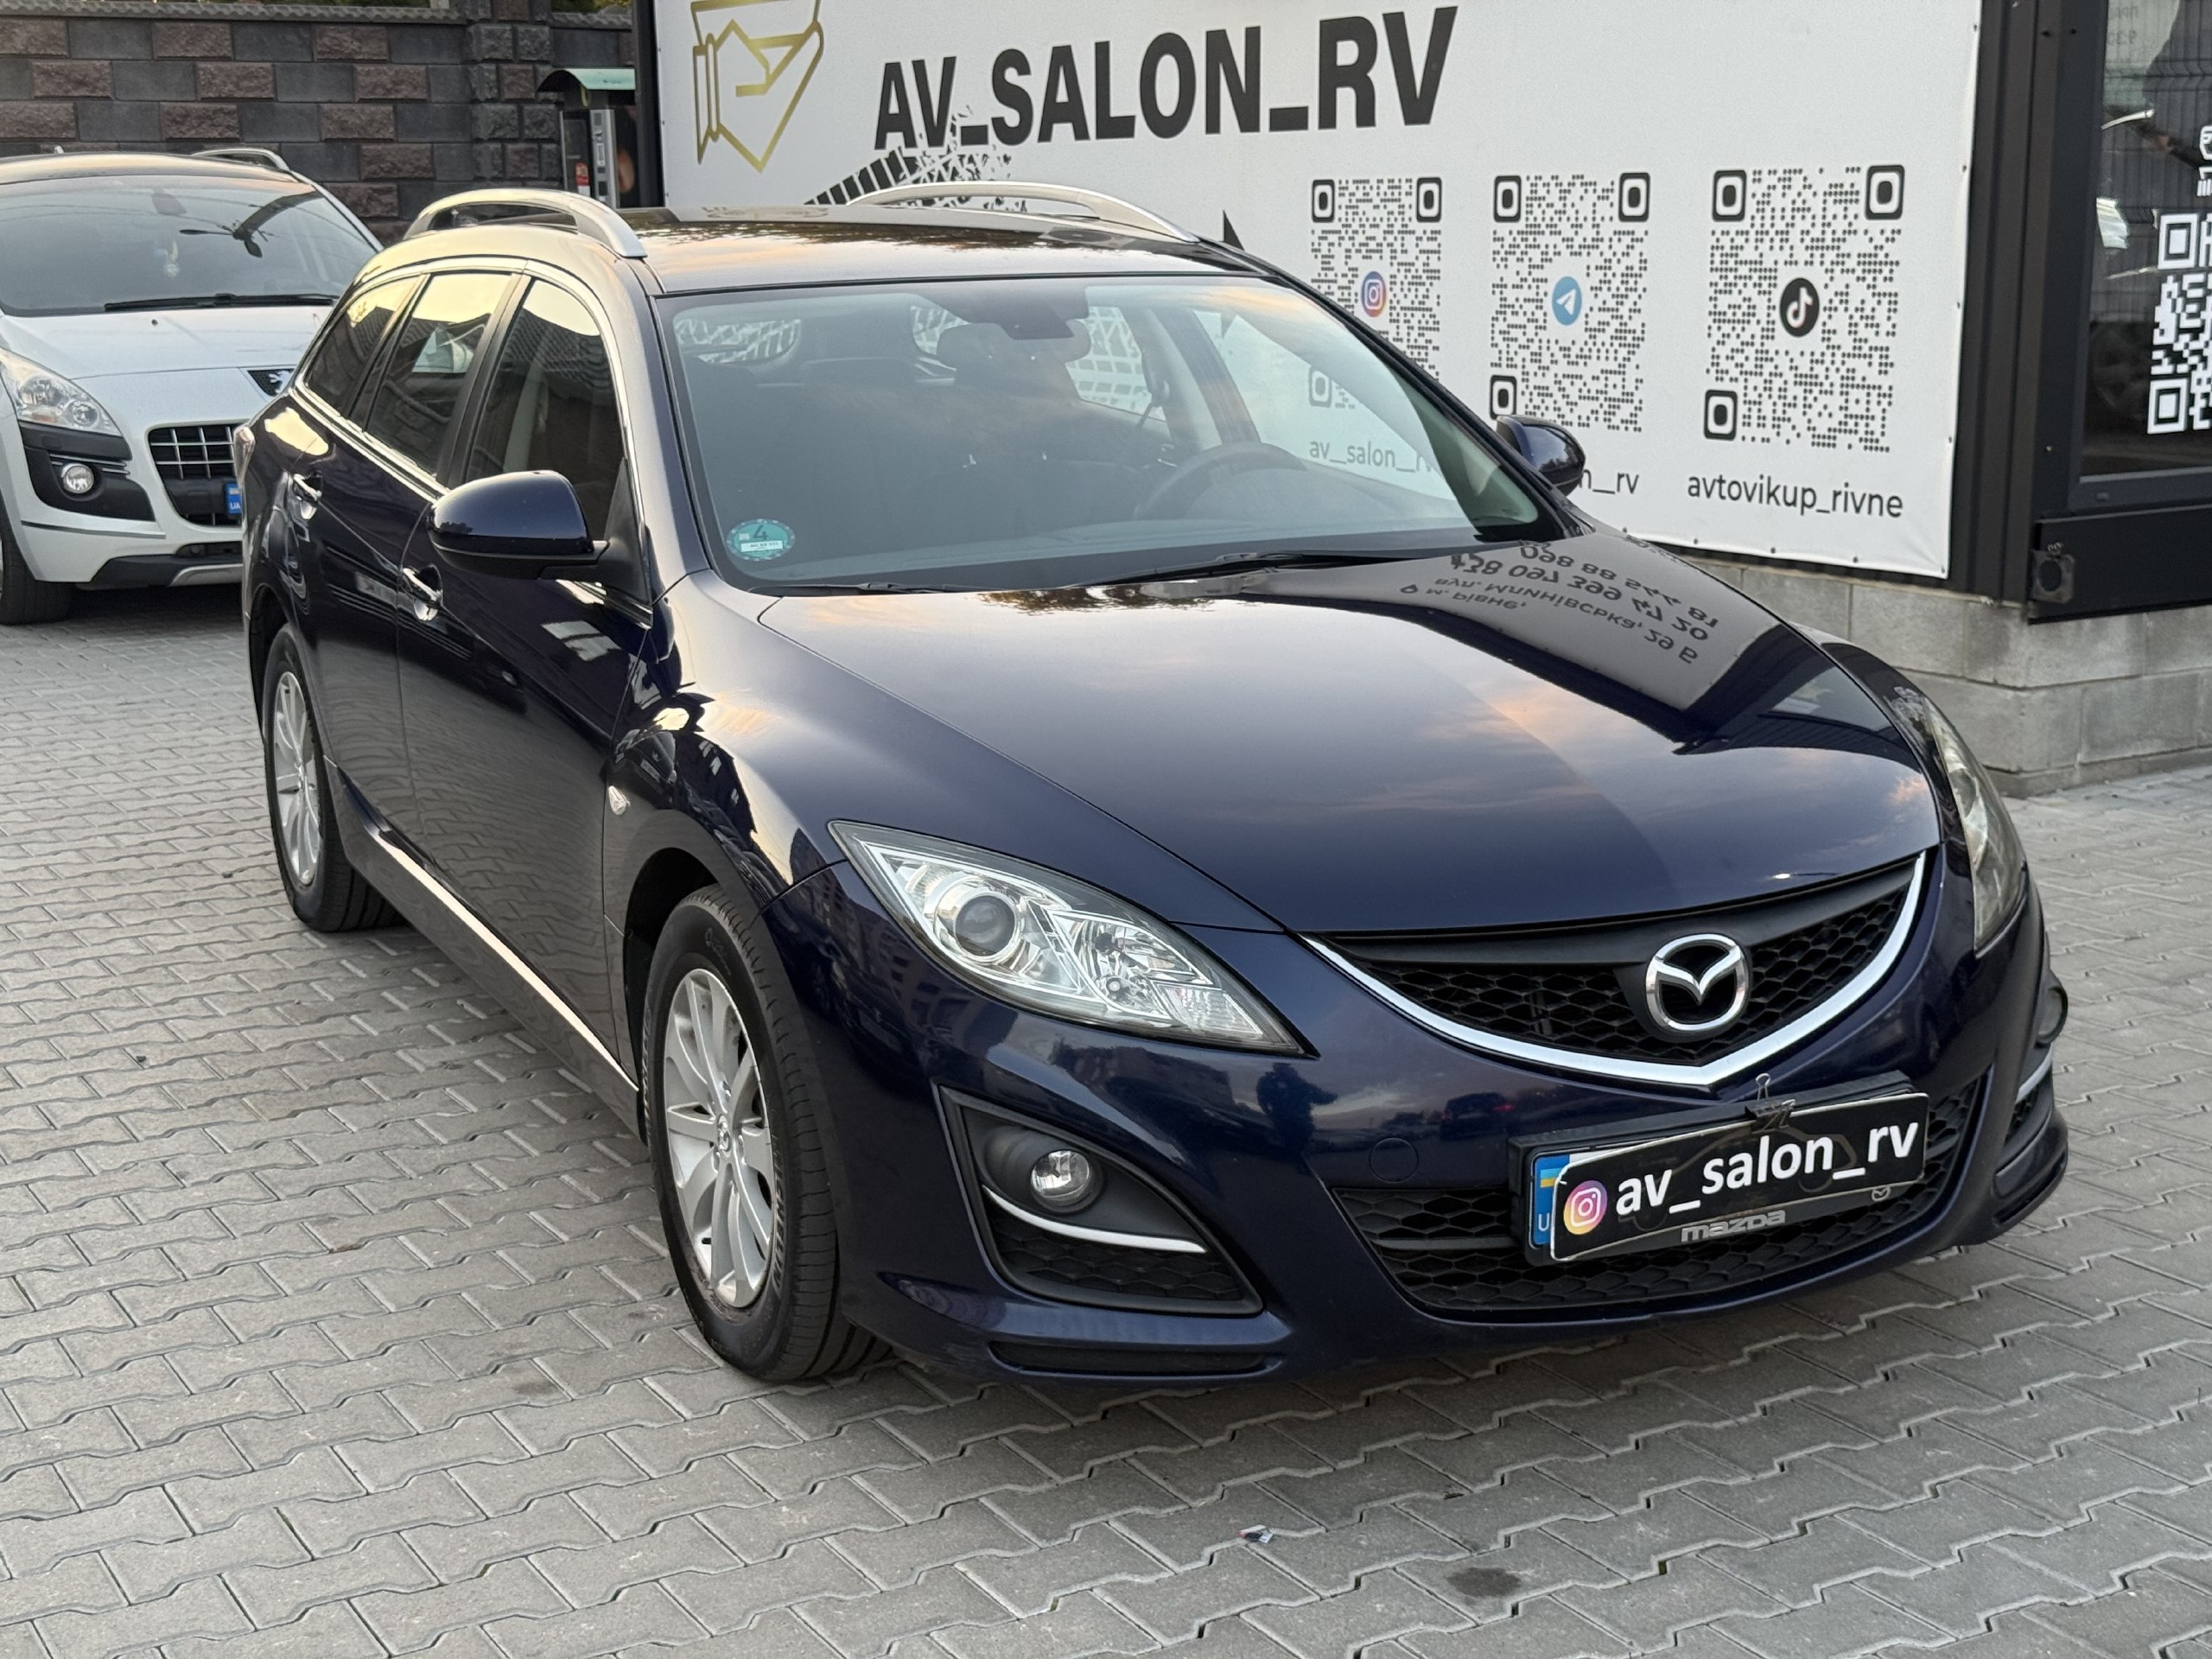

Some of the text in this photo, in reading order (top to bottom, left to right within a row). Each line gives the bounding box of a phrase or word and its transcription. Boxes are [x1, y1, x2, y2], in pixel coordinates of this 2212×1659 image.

[874, 5, 1459, 150] AV_SALON_RV
[1688, 474, 1904, 518] avtovikup_rivne
[1615, 1122, 1919, 1216] av_salon_rv
[1538, 1212, 1550, 1231] U
